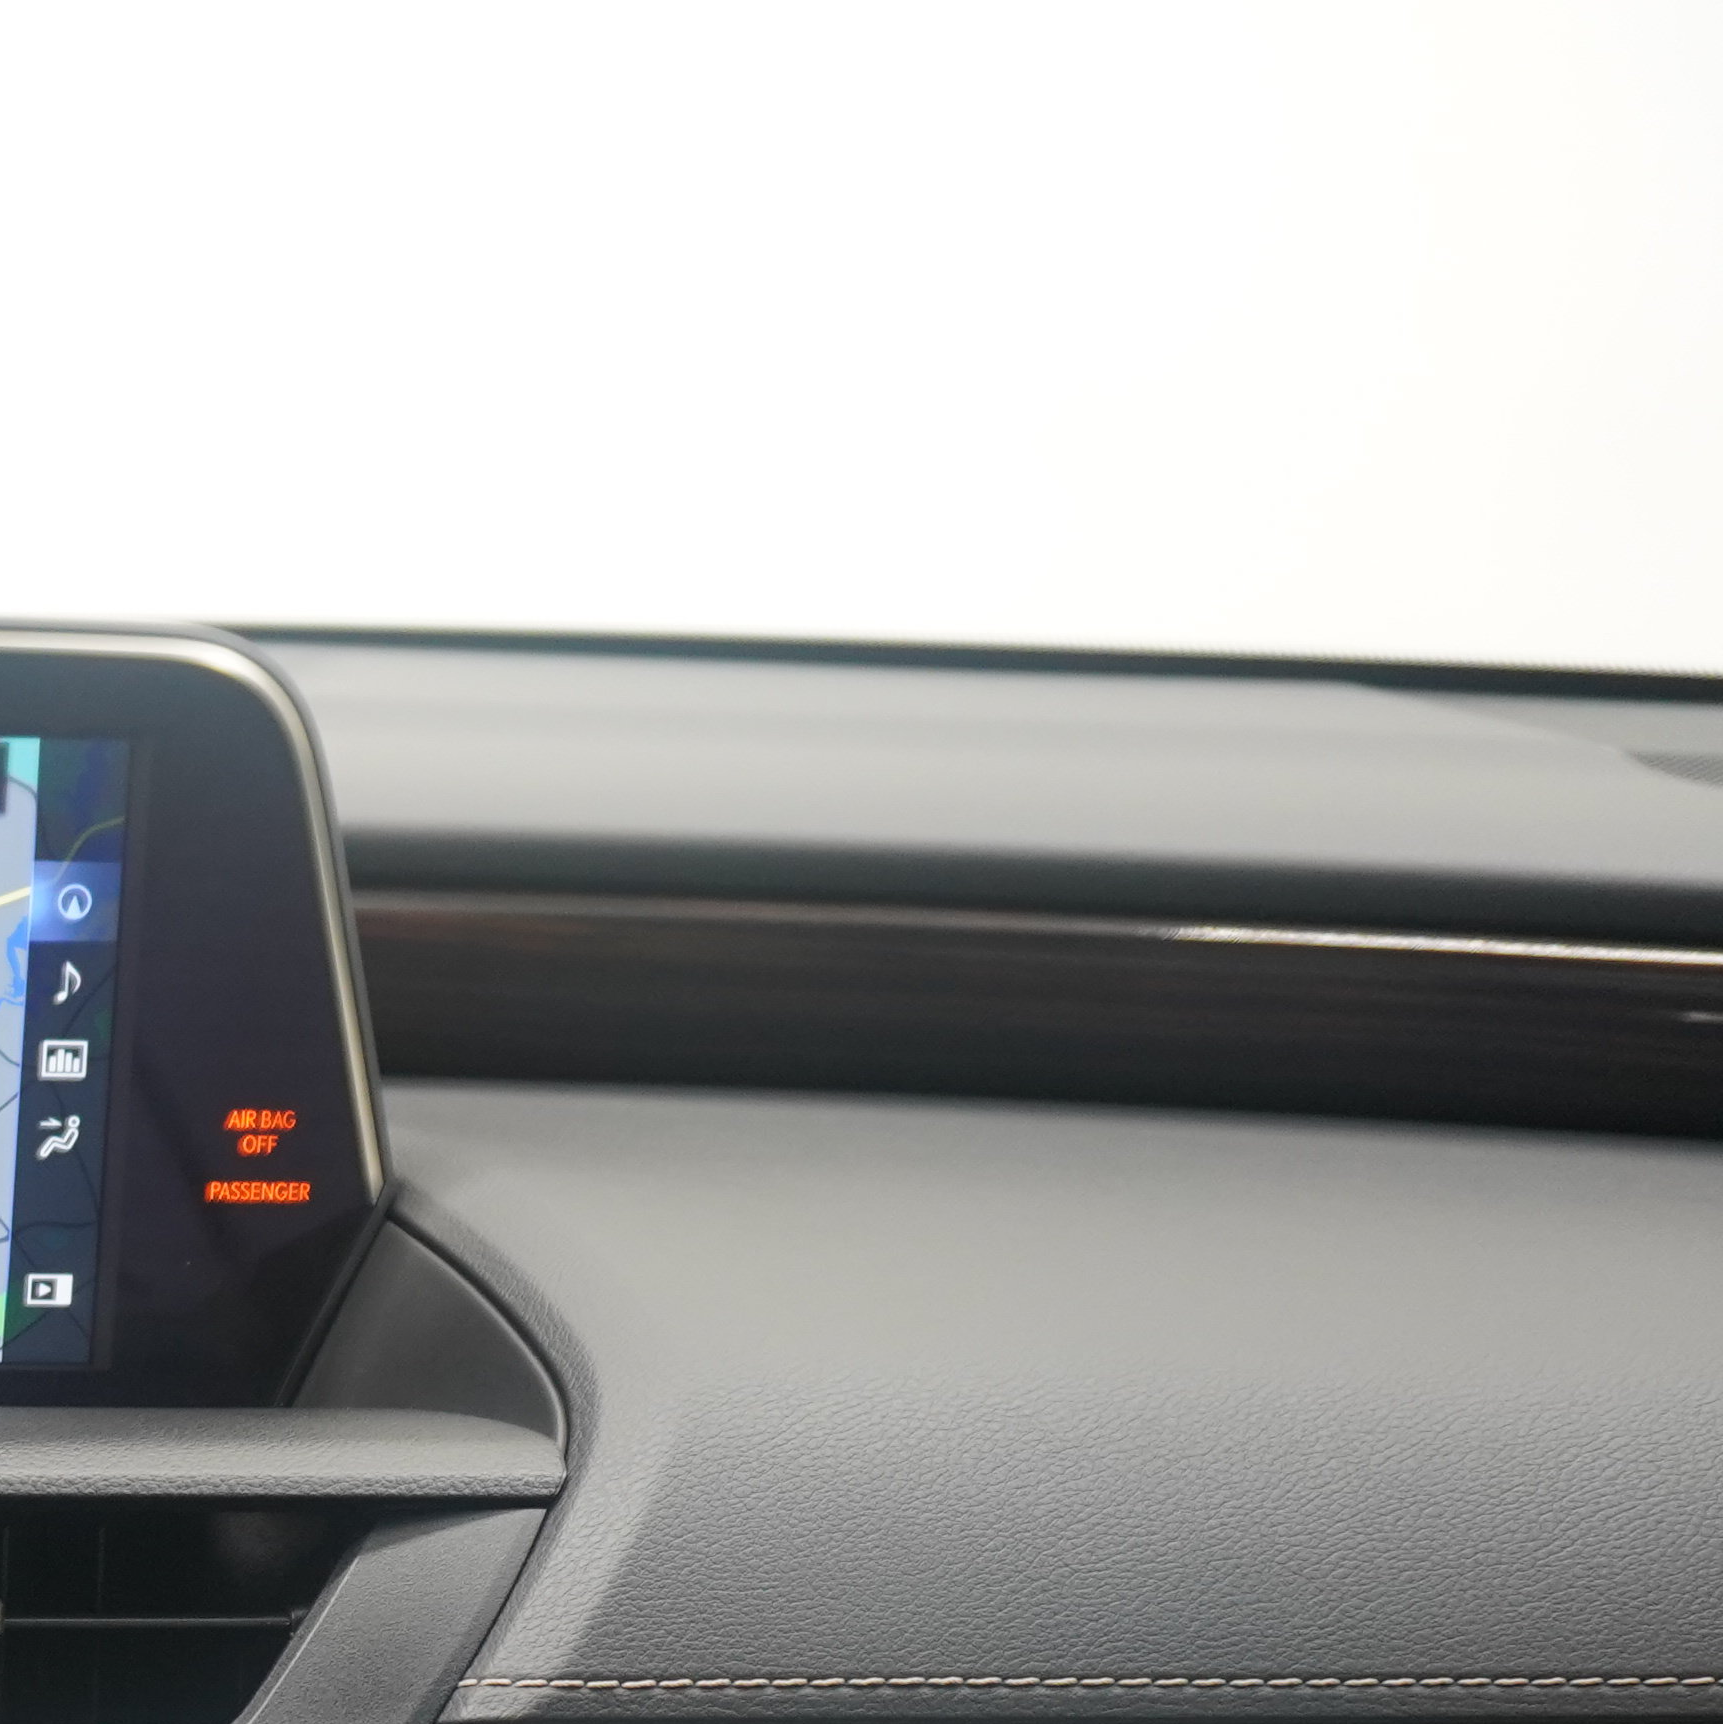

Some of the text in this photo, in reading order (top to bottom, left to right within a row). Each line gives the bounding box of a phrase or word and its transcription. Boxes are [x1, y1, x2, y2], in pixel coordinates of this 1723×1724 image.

[226, 1109, 296, 1129] AIR BAG
[238, 1134, 278, 1155] OFF
[206, 1181, 310, 1203] PASSENGER
